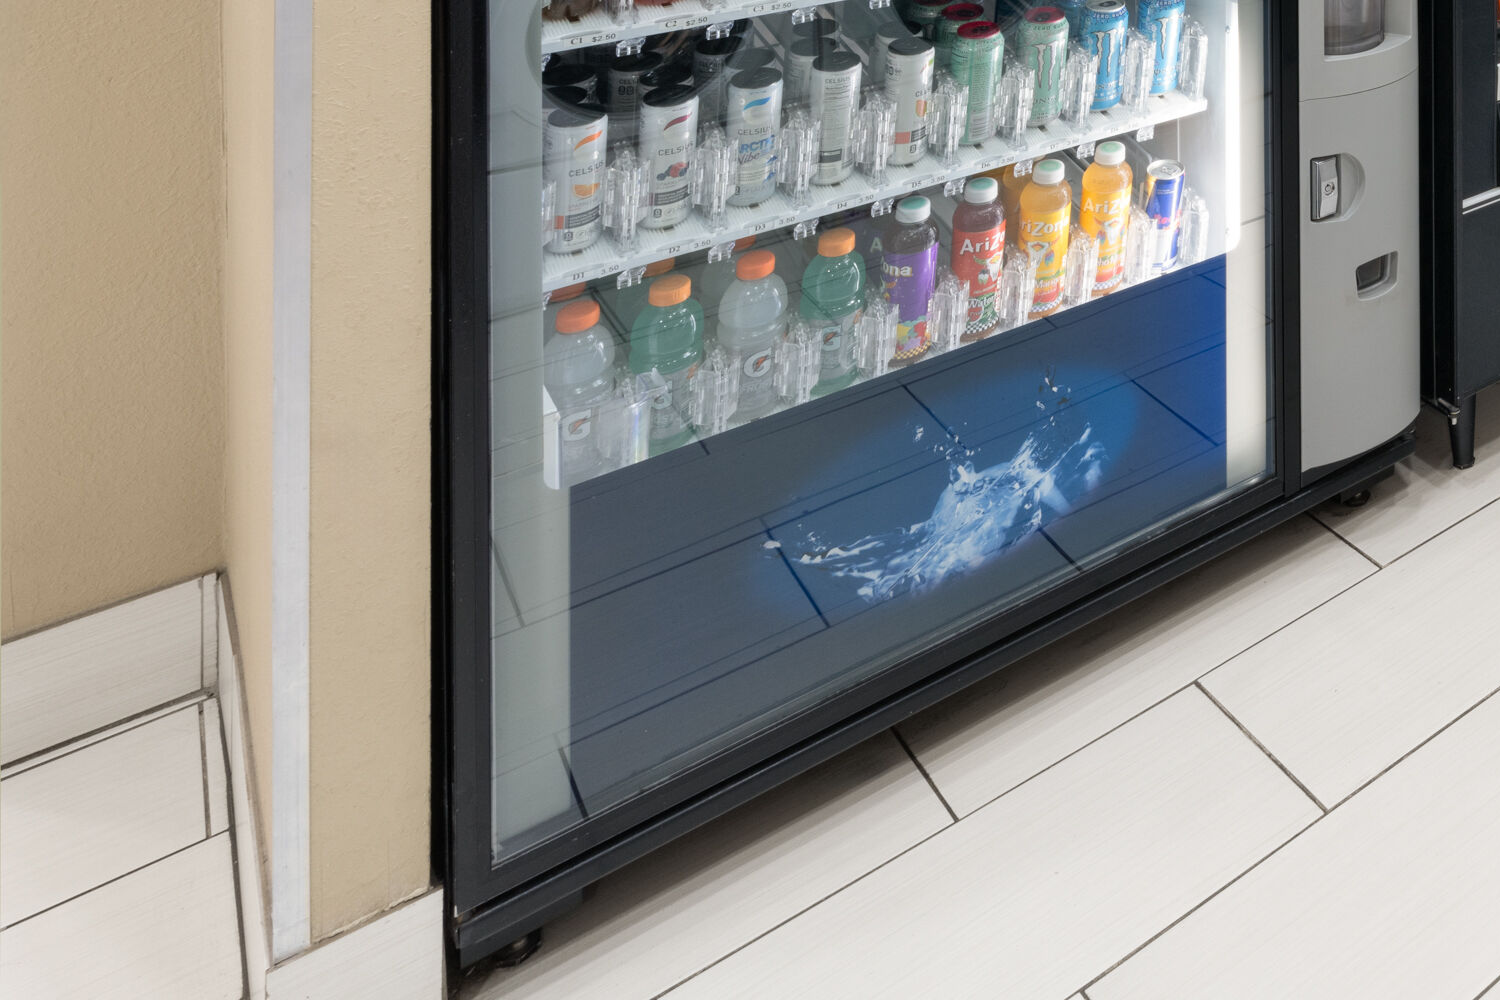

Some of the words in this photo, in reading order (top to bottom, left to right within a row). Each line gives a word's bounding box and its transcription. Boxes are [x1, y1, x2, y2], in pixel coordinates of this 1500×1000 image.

[753, 4, 764, 12] C3
[771, 2, 791, 10] $2.50
[686, 16, 708, 26] $2.50
[570, 36, 582, 44] C1
[592, 33, 616, 43] $2.50
[658, 142, 694, 156] CELSIUS
[754, 223, 765, 231] D3
[779, 216, 795, 225] 3.50
[669, 245, 680, 253] D2
[694, 239, 711, 248] 3.50
[960, 232, 1006, 255] AriZo
[572, 272, 584, 280] D1
[600, 264, 619, 274] 3.50
